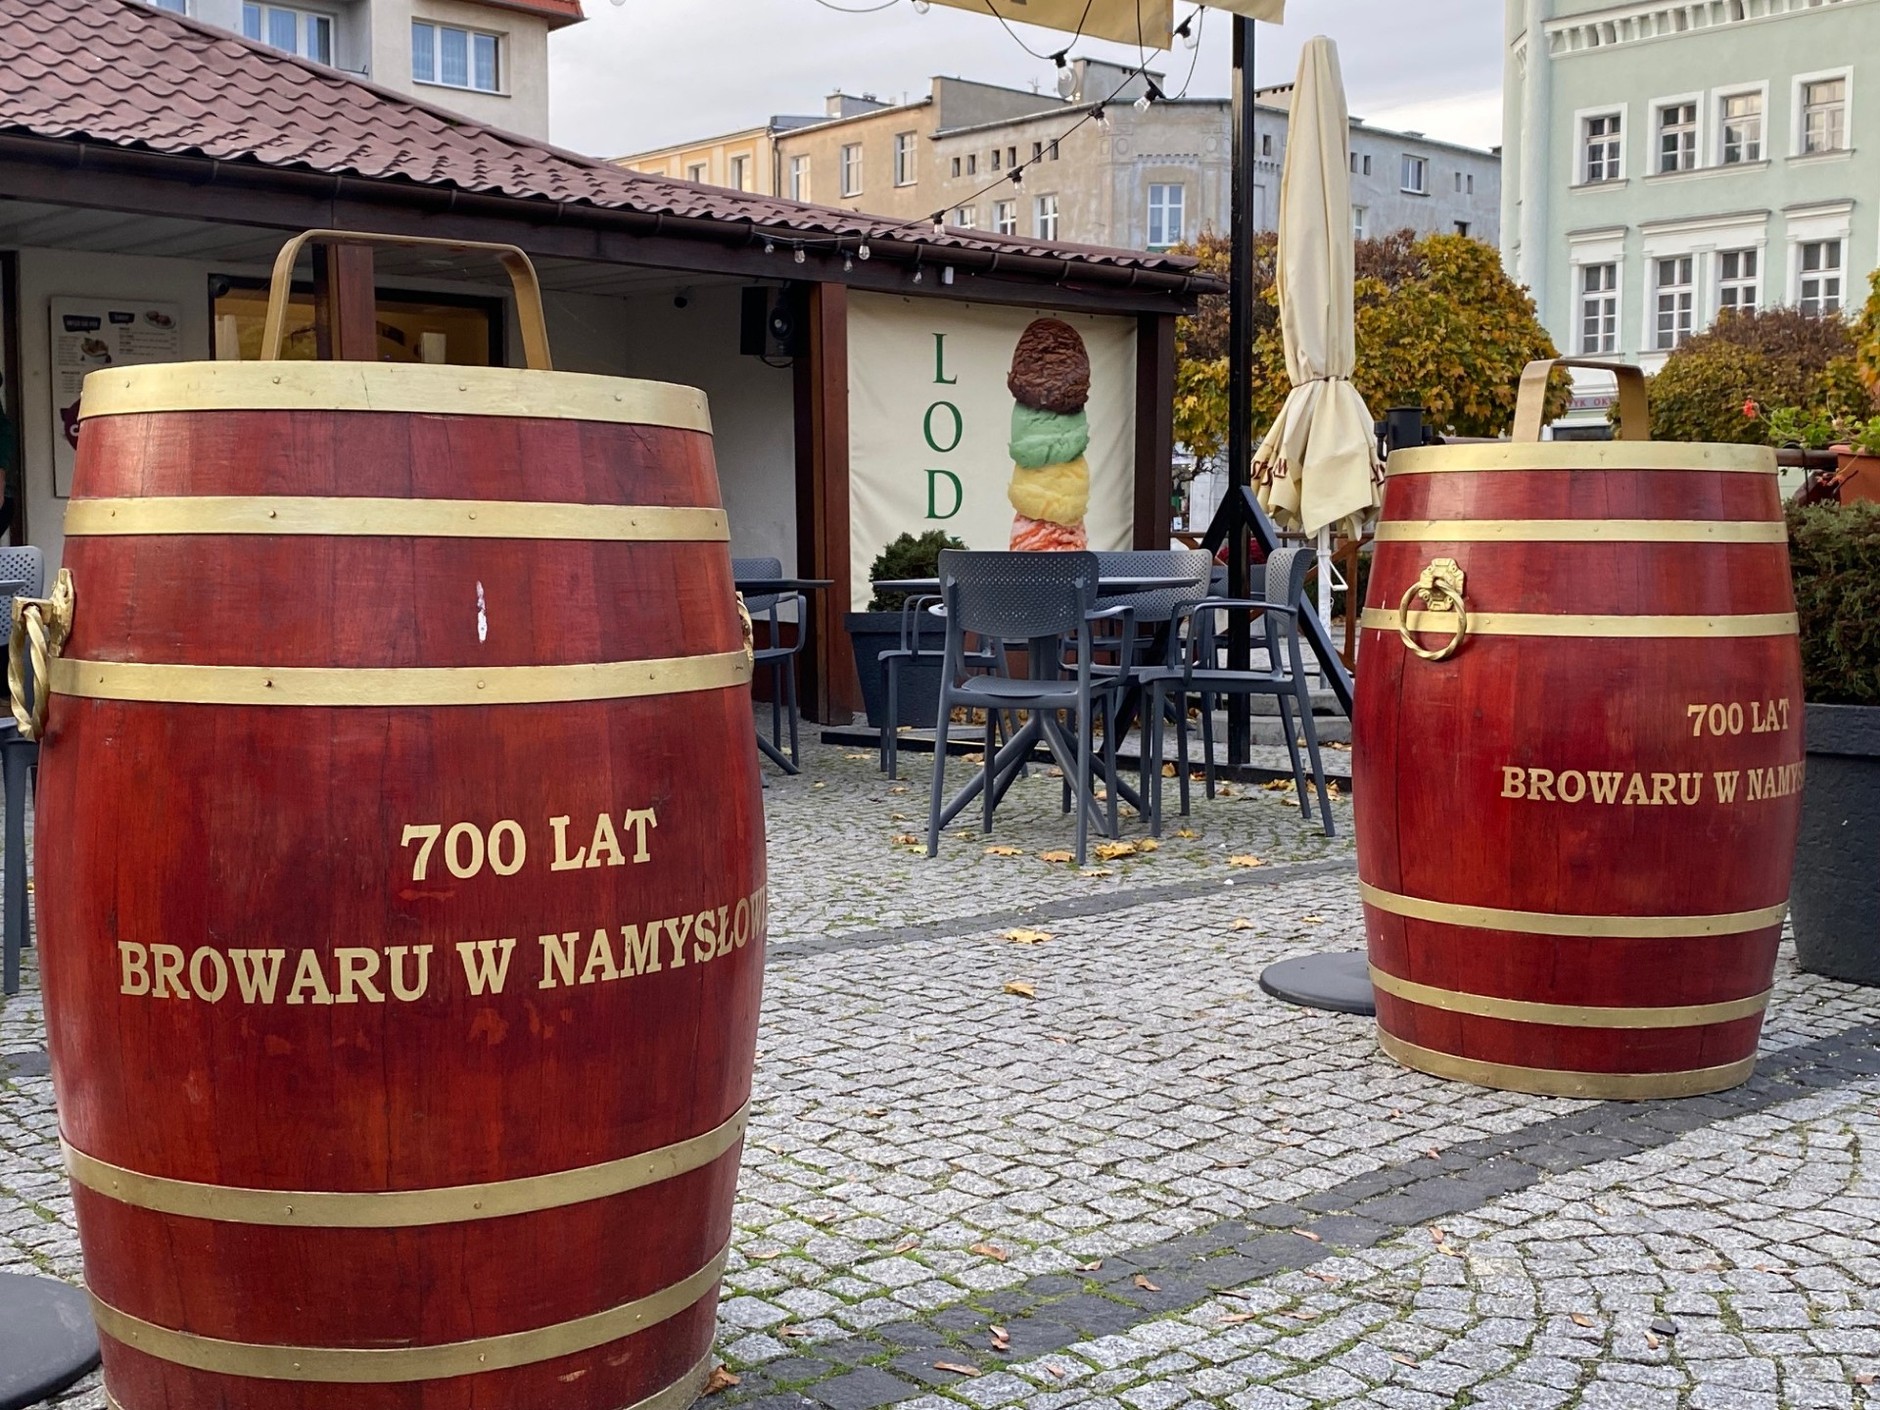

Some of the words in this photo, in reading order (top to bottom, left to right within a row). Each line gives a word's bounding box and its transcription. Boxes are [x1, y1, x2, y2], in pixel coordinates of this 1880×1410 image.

[923, 332, 963, 543] LOD
[1687, 703, 1744, 737] 700
[1750, 698, 1790, 733] LAT
[1500, 765, 1704, 806] BROWARU
[1713, 770, 1740, 804] W
[400, 818, 527, 881] 700
[549, 807, 658, 872] LAT
[117, 940, 433, 1005] BROWARU
[455, 938, 517, 996] W
